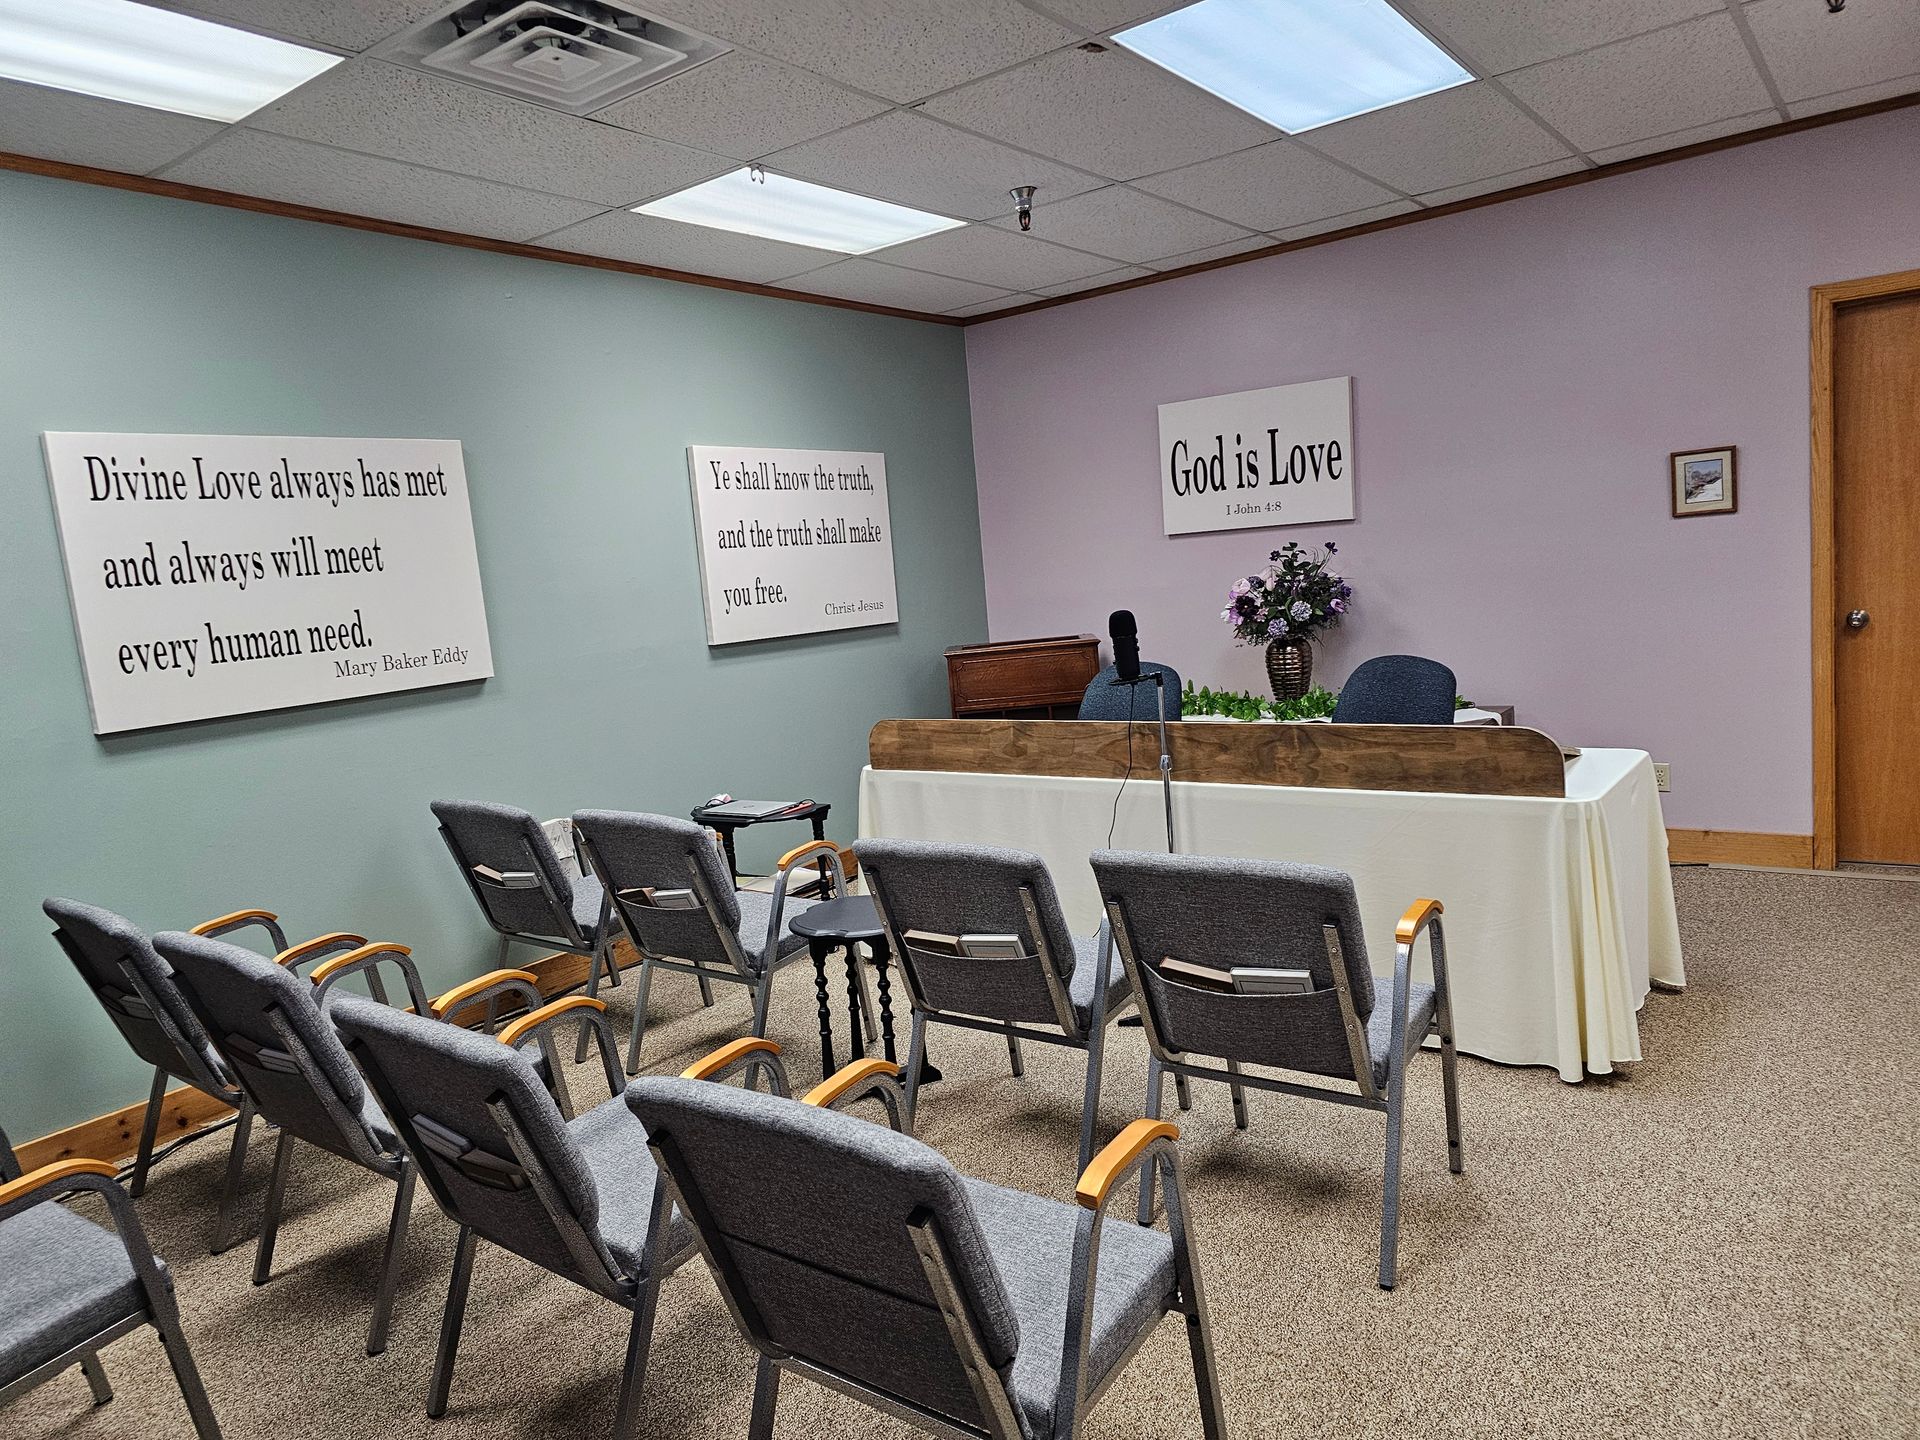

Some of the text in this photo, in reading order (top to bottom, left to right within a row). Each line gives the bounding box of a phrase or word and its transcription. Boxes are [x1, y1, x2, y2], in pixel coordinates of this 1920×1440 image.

[710, 461, 873, 495] Ye shall know the truth,
[1171, 428, 1342, 496] God is Love
[84, 456, 447, 507] Divine Love always has met
[1234, 503, 1261, 514] John
[1265, 501, 1281, 512] 4:8
[719, 518, 881, 549] and the truth shall make
[104, 536, 384, 590] and always will meet
[724, 577, 787, 614] you free.
[825, 600, 883, 615] Christ Jesus
[119, 609, 372, 677] every human need.
[334, 647, 468, 677] Mary Baker Eddy
